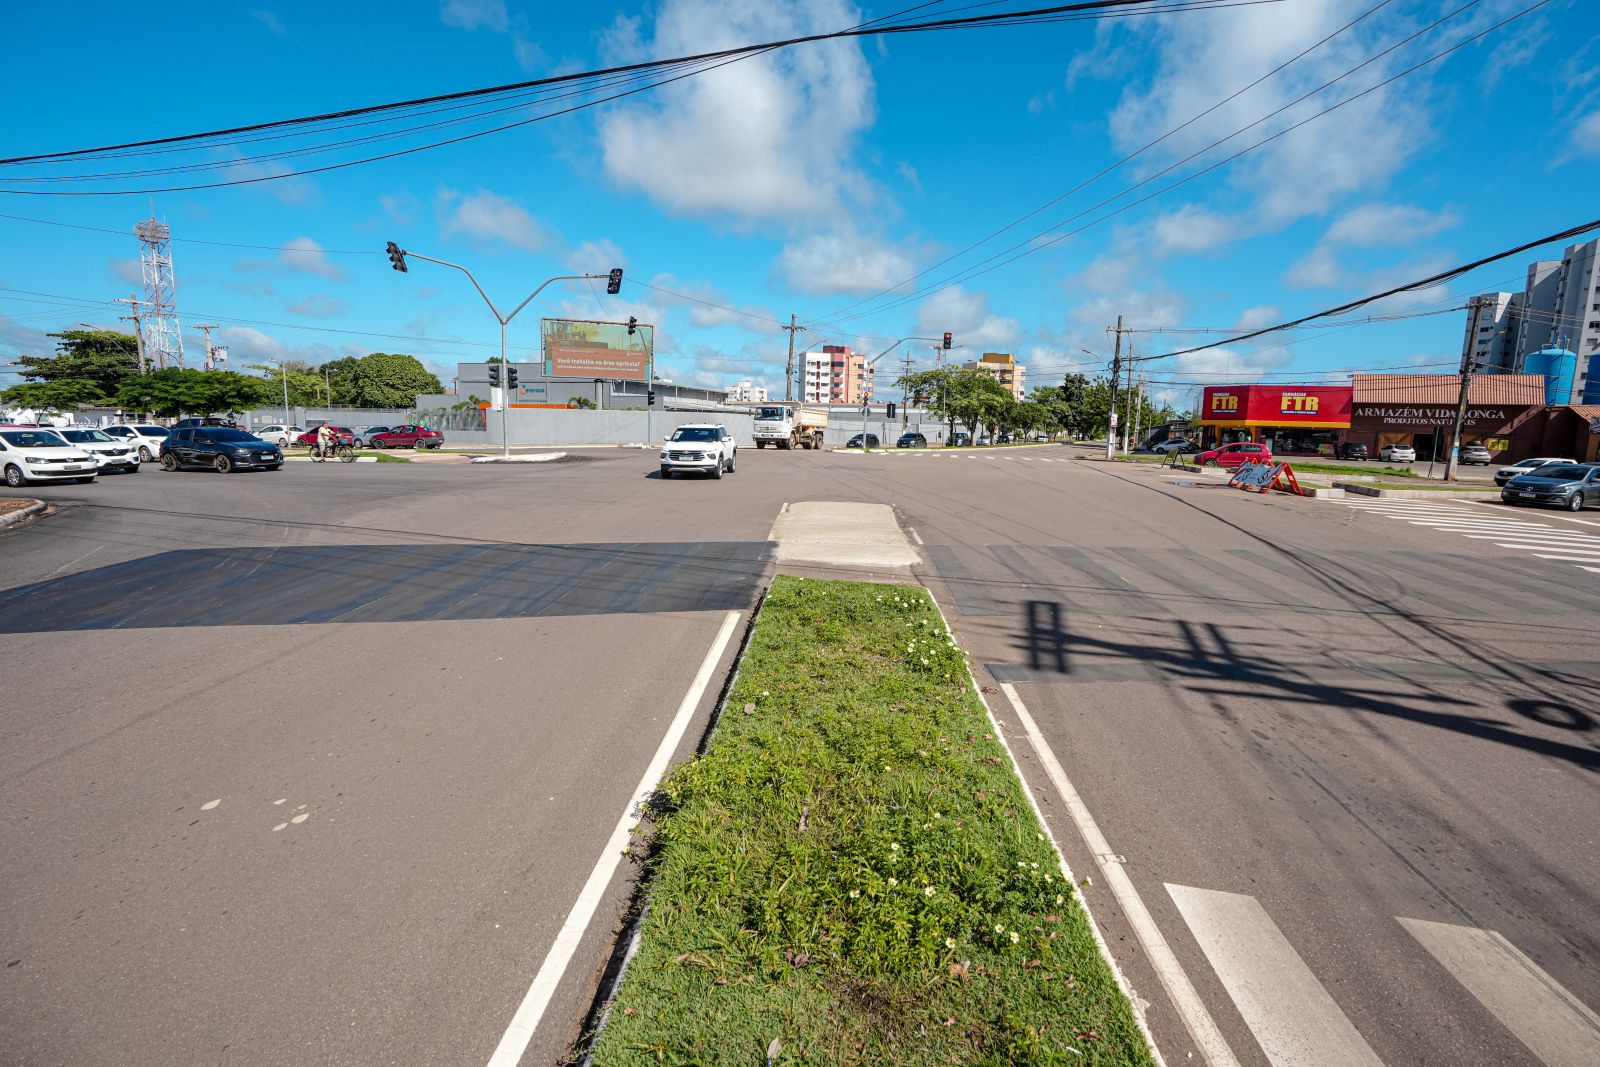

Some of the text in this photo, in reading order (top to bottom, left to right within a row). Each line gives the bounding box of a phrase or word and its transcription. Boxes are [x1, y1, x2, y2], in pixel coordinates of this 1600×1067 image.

[1212, 396, 1239, 410] FTR
[1280, 396, 1319, 411] FTR
[1355, 407, 1505, 419] ARMAZÉM VIDA ONGA
[1383, 417, 1428, 425] PRODUTOS
